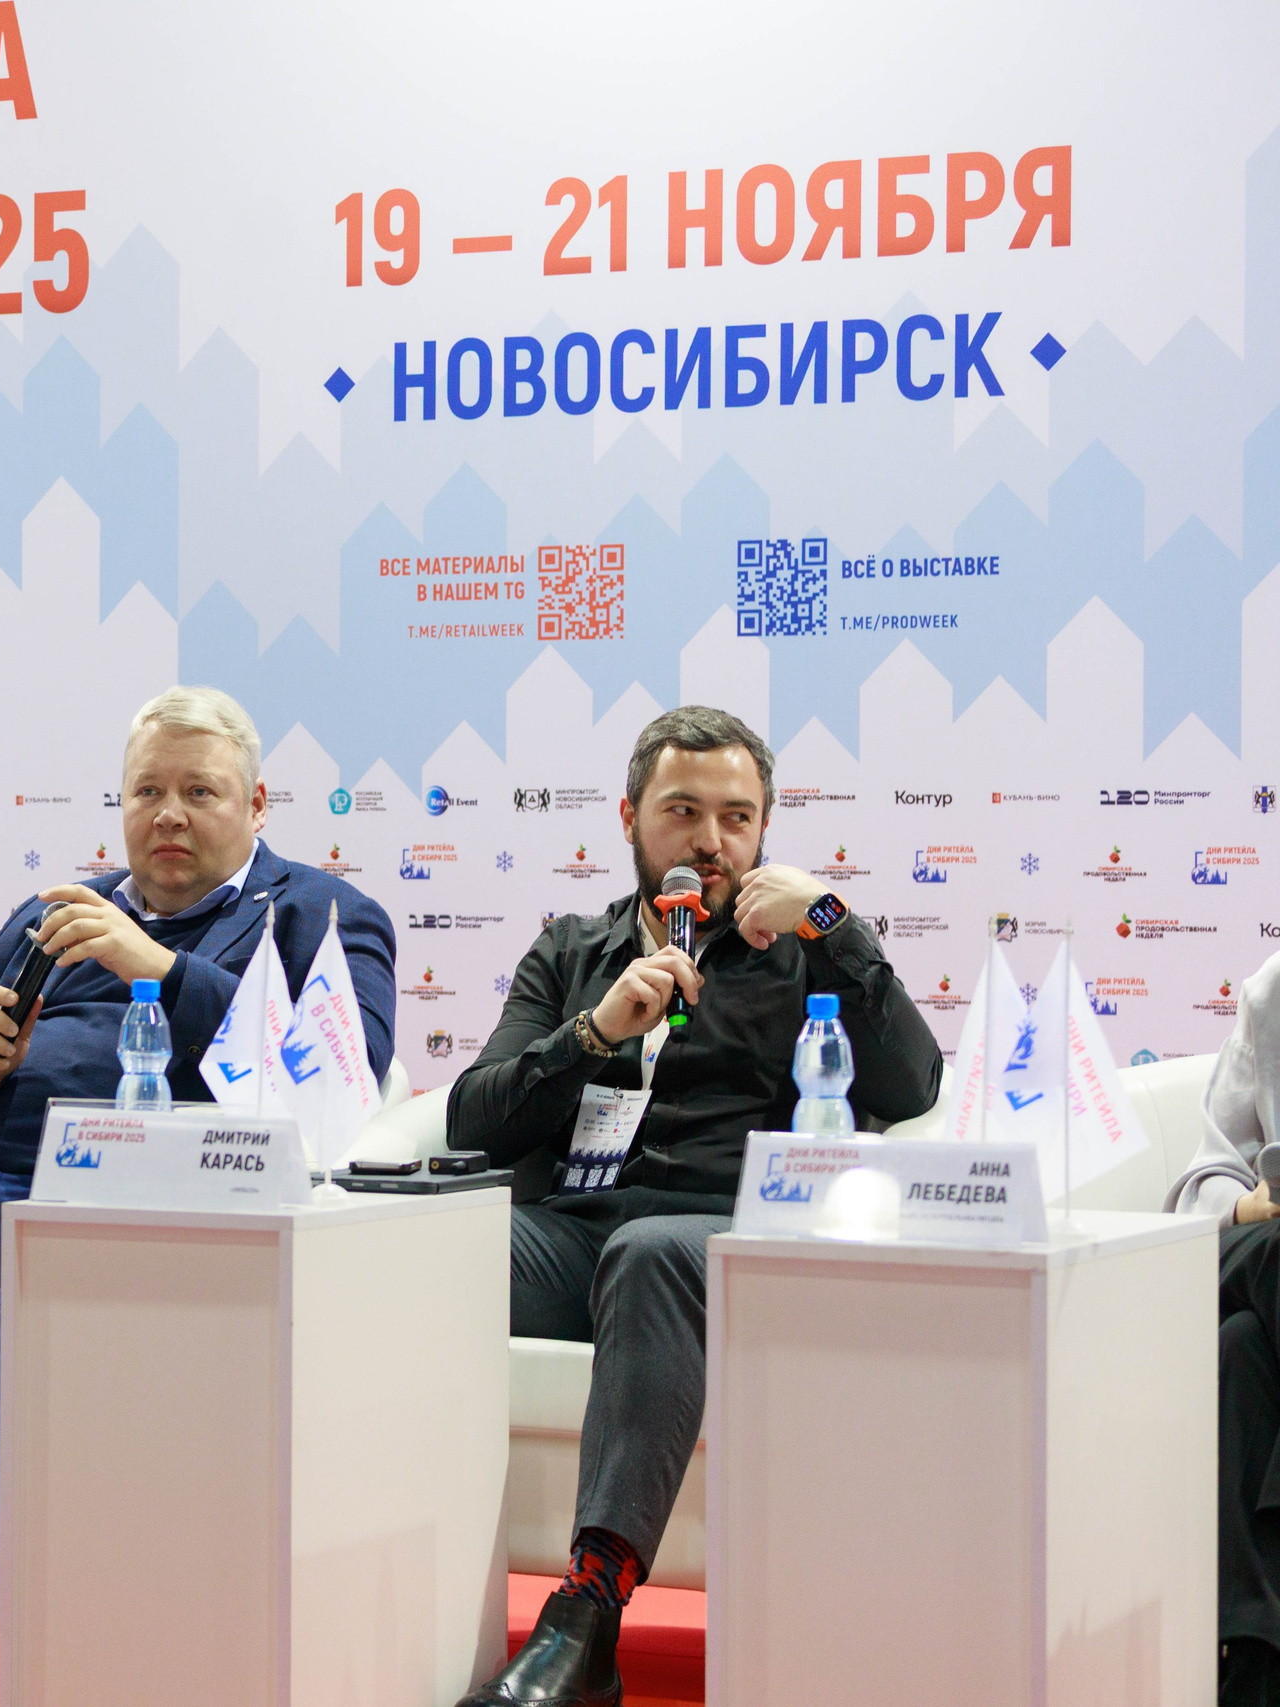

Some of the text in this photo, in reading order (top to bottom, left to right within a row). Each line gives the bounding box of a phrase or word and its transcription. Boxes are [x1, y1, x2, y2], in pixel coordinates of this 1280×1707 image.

[335, 188, 421, 288] 19
[543, 175, 628, 277] 21
[667, 145, 1072, 270] НОЯБРЯ
[393, 311, 1005, 422] НОВОСИБИРСК
[379, 555, 525, 578] ВСЕ МАТЕРИАЛЫ
[841, 555, 1000, 578] ВСЁ О ВЫСТАВКЕ
[417, 582, 525, 602] В НАШЕМ TG
[407, 621, 524, 640] T.ME/RETAILWEEK
[840, 613, 959, 632] T.ME/PRODWEEK
[456, 798, 478, 806] Event
[894, 790, 953, 808] Контур
[1154, 791, 1211, 799] Минпромторг
[427, 843, 455, 851] РИТЕЙЛА
[943, 845, 974, 853] РИТЕЙЛА
[1206, 846, 1256, 856] ДНИ РИТЕЙЛА
[1206, 857, 1260, 865] В СИБИРИ 2025
[455, 915, 504, 924] Минпромторг
[1096, 977, 1145, 986] ДНИ РИТЕЙЛА
[310, 1004, 353, 1087] В СИБИРИ
[1083, 1058, 1123, 1144] РИТЕЙЛА
[81, 1117, 144, 1129] ДНИ РИТЕЙЛА
[78, 1131, 145, 1143] В СИБИРИ 2025
[202, 1129, 271, 1146] ДМИТРИЙ
[786, 1147, 809, 1159] ДНИ
[200, 1152, 265, 1172] КАРАСЬ
[794, 1163, 835, 1174] СИБИРИ
[969, 1161, 1011, 1177] АННА
[908, 1183, 1008, 1205] ЛЕБЕДЕВА
